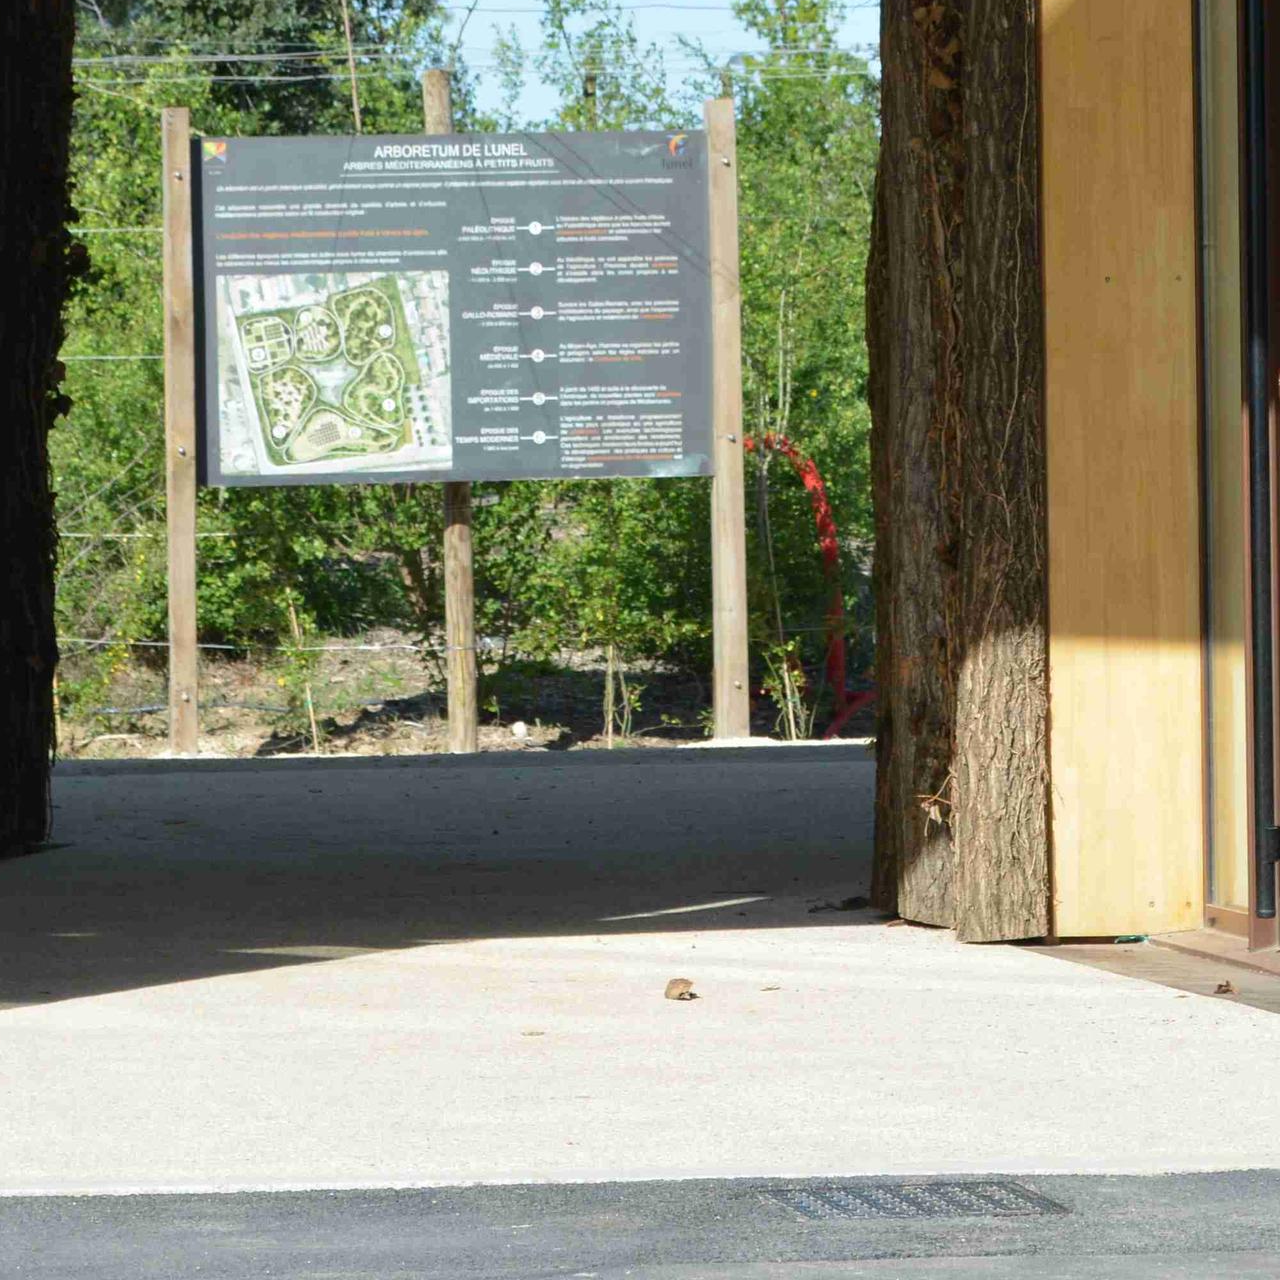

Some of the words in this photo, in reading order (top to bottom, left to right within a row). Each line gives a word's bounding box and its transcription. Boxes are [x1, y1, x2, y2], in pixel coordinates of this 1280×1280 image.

[374, 144, 459, 159] ARBORETUM
[462, 143, 481, 157] DE
[484, 142, 528, 157] LUNEL
[343, 161, 383, 171] ARBRES
[475, 157, 483, 169] À
[484, 158, 518, 169] PETITS
[519, 158, 555, 168] FRUITS
